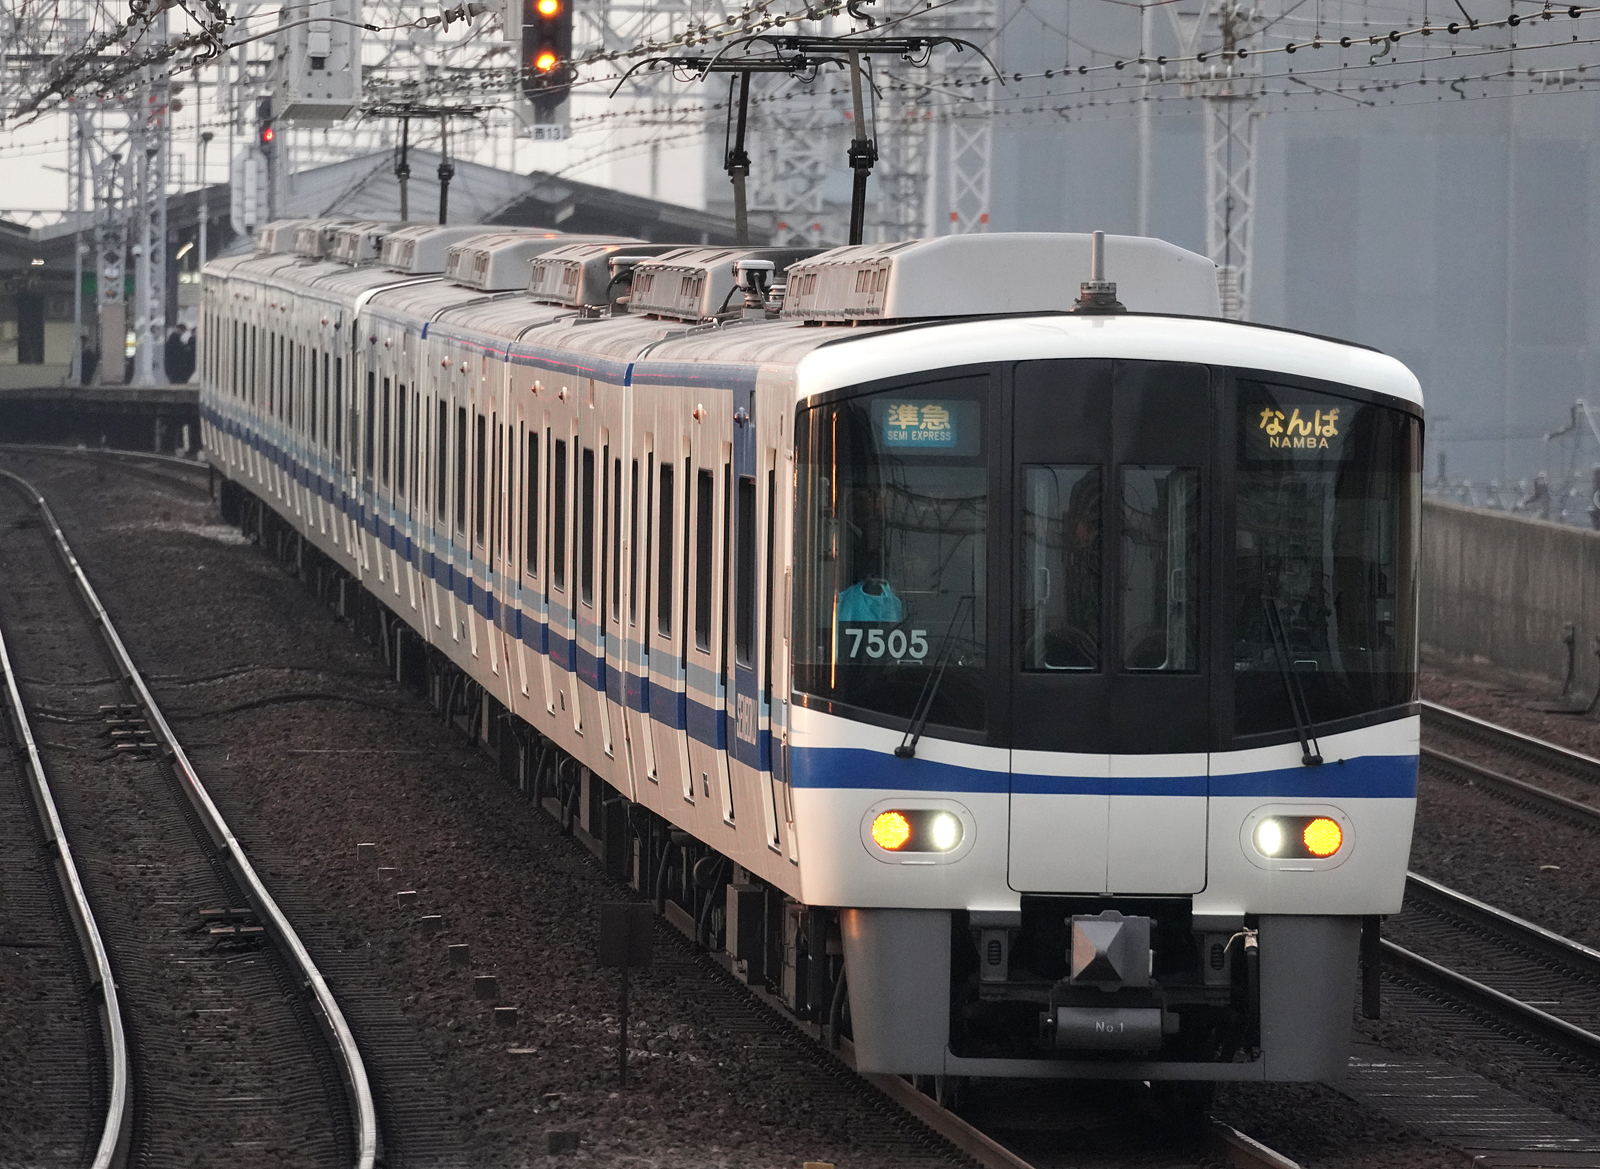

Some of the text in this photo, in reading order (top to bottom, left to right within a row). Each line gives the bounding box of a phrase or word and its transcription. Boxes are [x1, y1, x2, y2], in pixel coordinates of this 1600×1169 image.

[888, 404, 951, 430] 準急
[1260, 407, 1340, 437] なんば
[887, 431, 952, 441] SEMI EXPRESS
[1269, 437, 1329, 449] NAMBA
[845, 628, 929, 659] 7505
